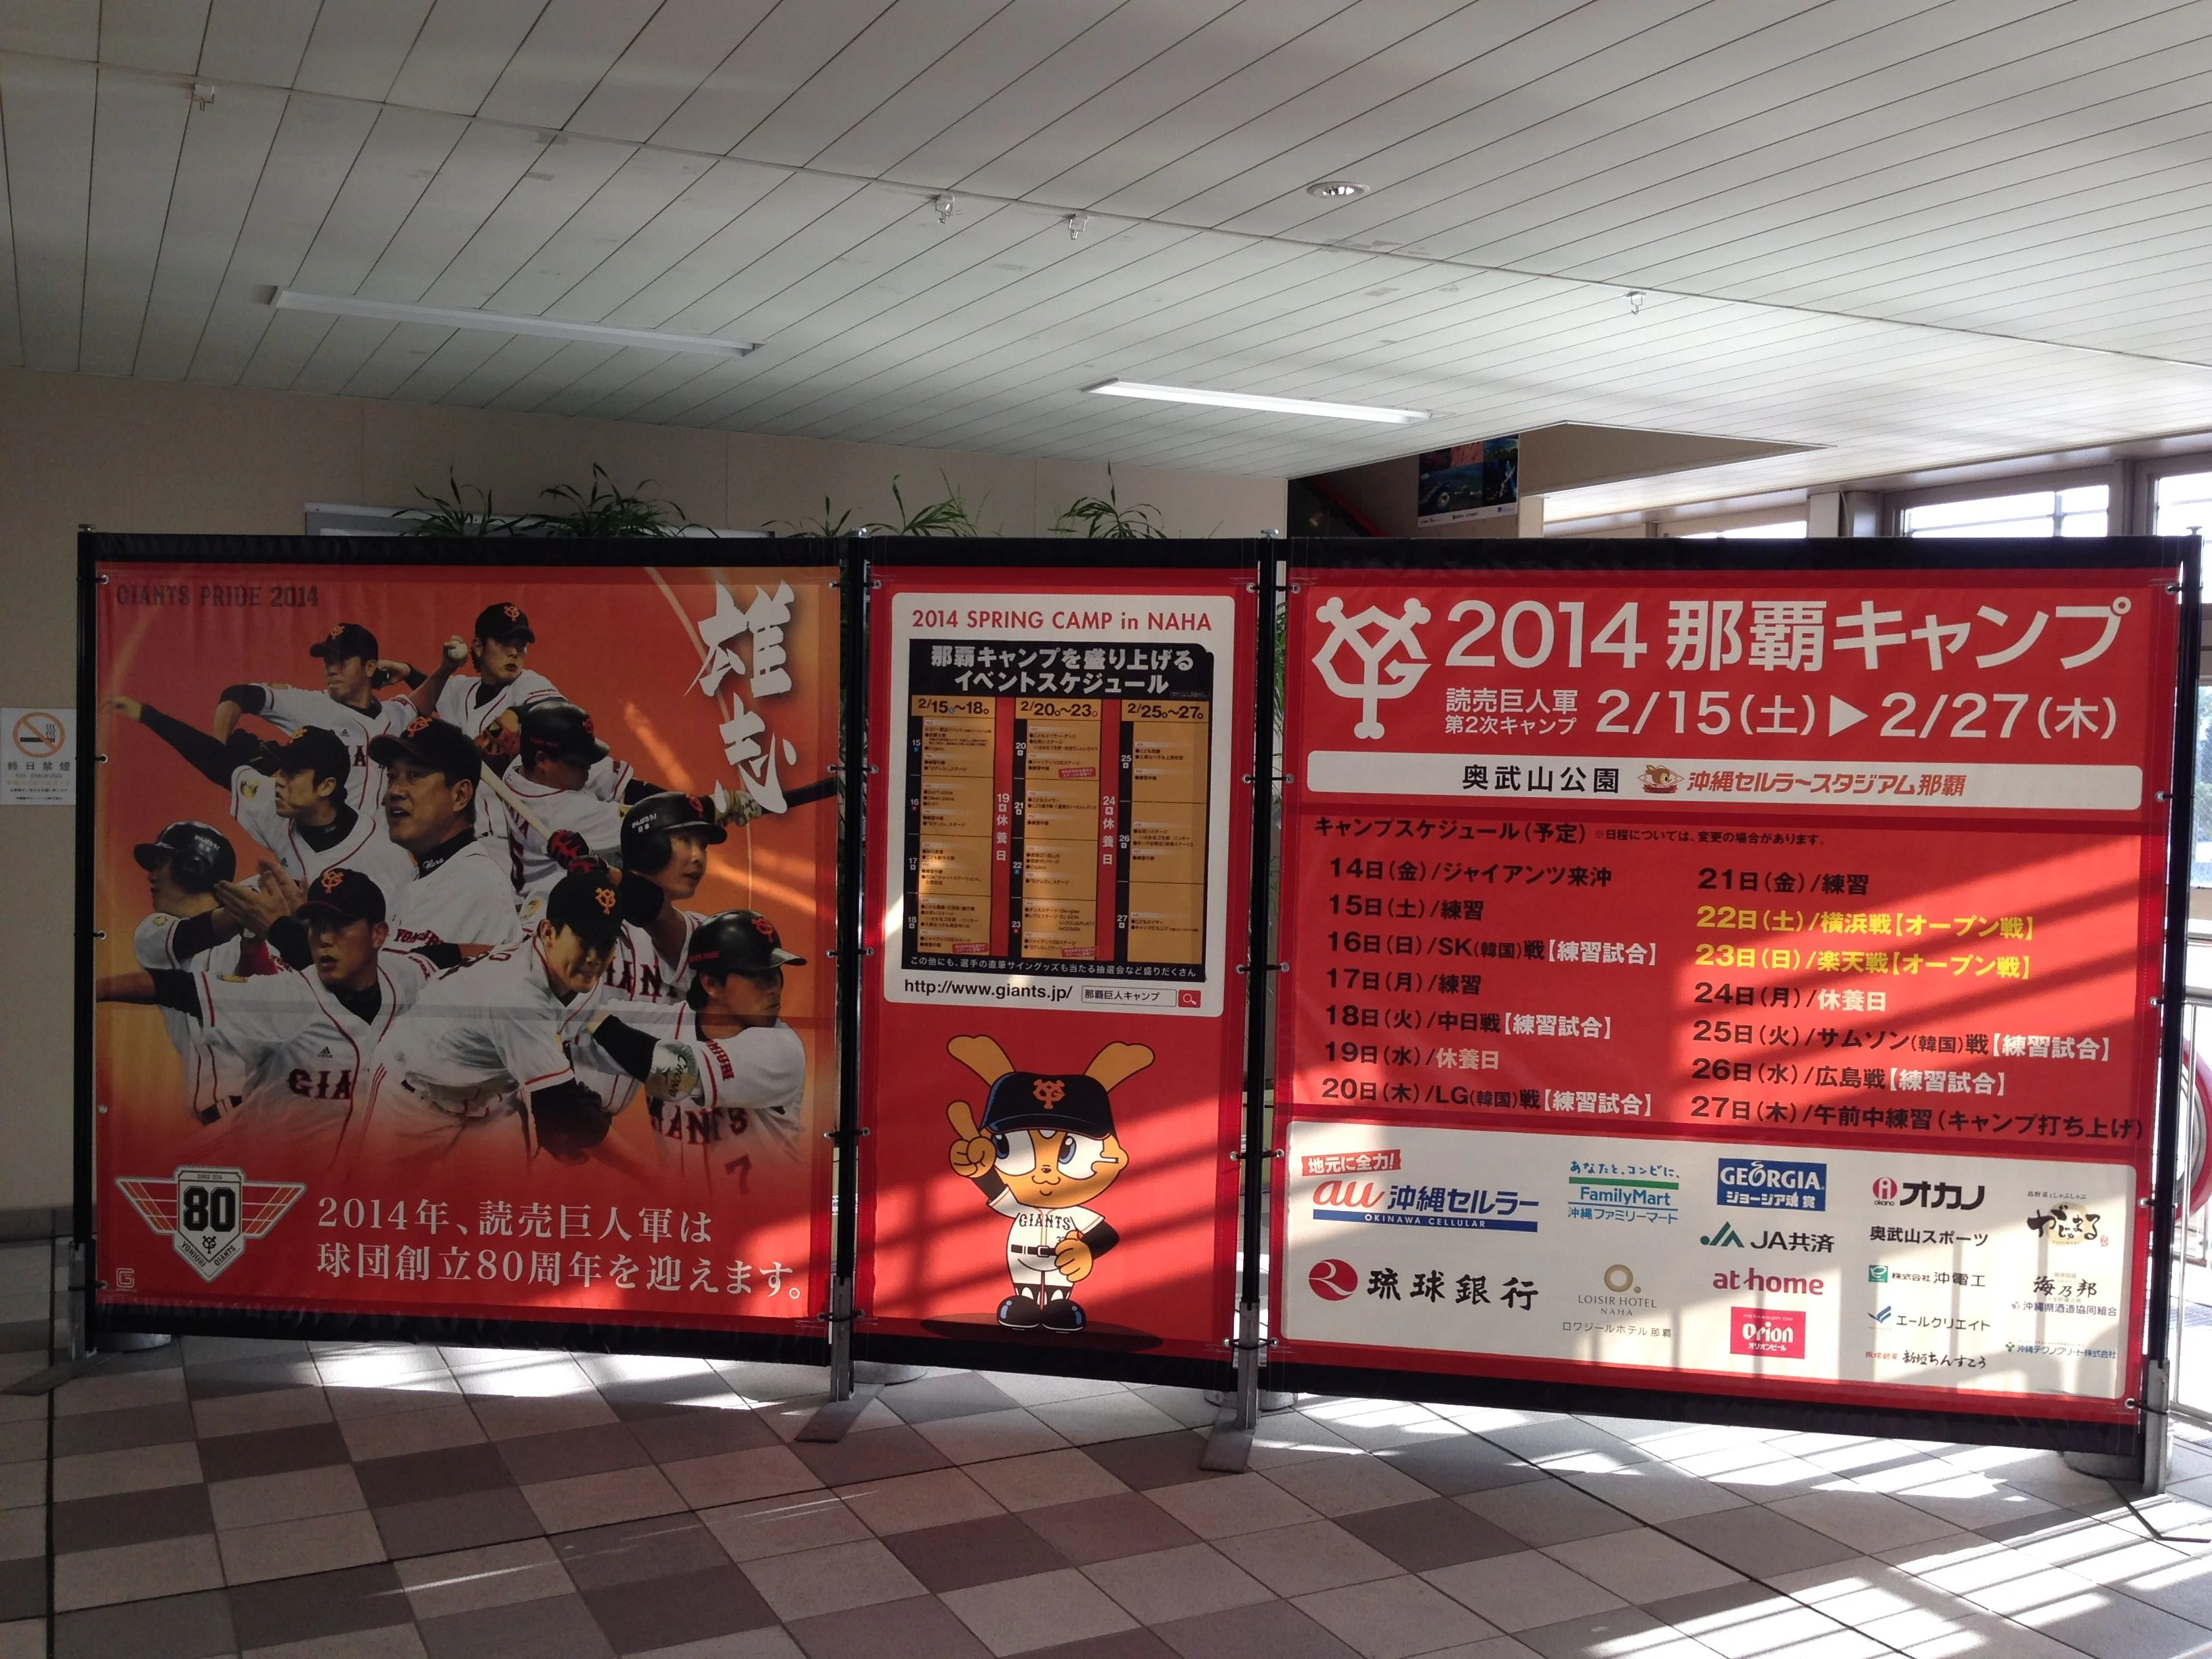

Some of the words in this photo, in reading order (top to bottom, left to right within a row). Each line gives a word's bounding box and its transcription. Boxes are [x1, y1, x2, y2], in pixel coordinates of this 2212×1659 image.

[116, 583, 191, 606] GIANTS
[199, 585, 262, 607] PRIDE
[270, 585, 320, 608] 2014
[912, 609, 959, 628] 2014
[966, 611, 1045, 630] SPRING
[1052, 611, 1113, 630] CAMP
[1121, 612, 1139, 630] in
[1147, 613, 1212, 632] NAHA
[1444, 600, 1647, 668] 2014
[1666, 596, 2132, 672] 那覇キャンプ
[930, 644, 1195, 672] 那覇キャンプを盛り上げる
[954, 671, 1170, 695] イベントスケジュール
[1446, 688, 1578, 714] 読売巨人軍
[1444, 715, 1578, 735] 第2次キャンプ
[1596, 689, 1816, 736] 2/15(土)
[1880, 691, 2117, 739] 2/27(木)
[1121, 754, 1132, 762] 25
[1461, 764, 1620, 794] 奥武山公園
[1686, 770, 1967, 798] 沖縄セルラースタジアム那覇
[997, 793, 1010, 803] 19
[1103, 796, 1116, 806] 24
[1314, 817, 1586, 844] キャンプスケジュール(予定)
[1330, 857, 1612, 888] 14日(金)/ジャイアンツ来沖
[1697, 867, 1870, 897] 21日(金)/練習
[1117, 914, 1128, 922] 27
[1328, 895, 1484, 921] 15日(土)/練習
[909, 956, 1197, 977] この他にも、選手の直筆サイングッズも当たる抽選会など盛りだくさん
[904, 979, 1073, 1001] http://www.giants.jp/
[1326, 968, 1482, 996] 17日(月)/練習
[1084, 989, 1161, 1002] 那覇巨人キャンプ
[1694, 982, 1888, 1012] 24日(月)/休養日
[1324, 1041, 1500, 1071] 19日(水)/休養日
[1307, 1152, 1395, 1174] 地元に全力!
[1570, 1160, 1681, 1179] あなたと、コンビに、
[1719, 1161, 1822, 1191] GEORGIA
[1312, 1180, 1386, 1208] au
[1387, 1185, 1540, 1216] 沖縄セルラー
[1580, 1186, 1672, 1208] FamilyMart
[1899, 1181, 1986, 1210] オカノ
[183, 1186, 236, 1232] 80
[1567, 1206, 1679, 1225] 沖縄ファミリーマート
[317, 1197, 713, 1246] 2014年、読売巨人軍は
[1019, 1213, 1071, 1231] GIANTS
[1364, 1213, 1422, 1225] OKINAWA
[1428, 1217, 1487, 1229] CELLULAR
[1750, 1229, 1836, 1254] JA共済
[1869, 1225, 1989, 1247] 奥武山スポーツ
[213, 1244, 237, 1266] GIANTS
[316, 1243, 802, 1301] 球団創立80周年を迎えます。
[1712, 1269, 1741, 1290] at
[1742, 1266, 1824, 1296] home
[1891, 1271, 1931, 1283] 株式会社
[1933, 1271, 1987, 1288] 沖電工
[1366, 1267, 1540, 1311] 琉球銀行
[2032, 1275, 2097, 1298] 海乃邦
[1577, 1293, 1616, 1306] LOISIR
[1618, 1296, 1658, 1309] HOTEL
[1600, 1307, 1633, 1317] NAHA
[2022, 1301, 2118, 1317] 沖縄県酒造協同組合
[1742, 1321, 1795, 1343] Orion
[1896, 1314, 1991, 1332] エールクリエイト
[1748, 1342, 1787, 1352] オリオンビール
[1902, 1349, 1986, 1370] 新垣ちんすこう
